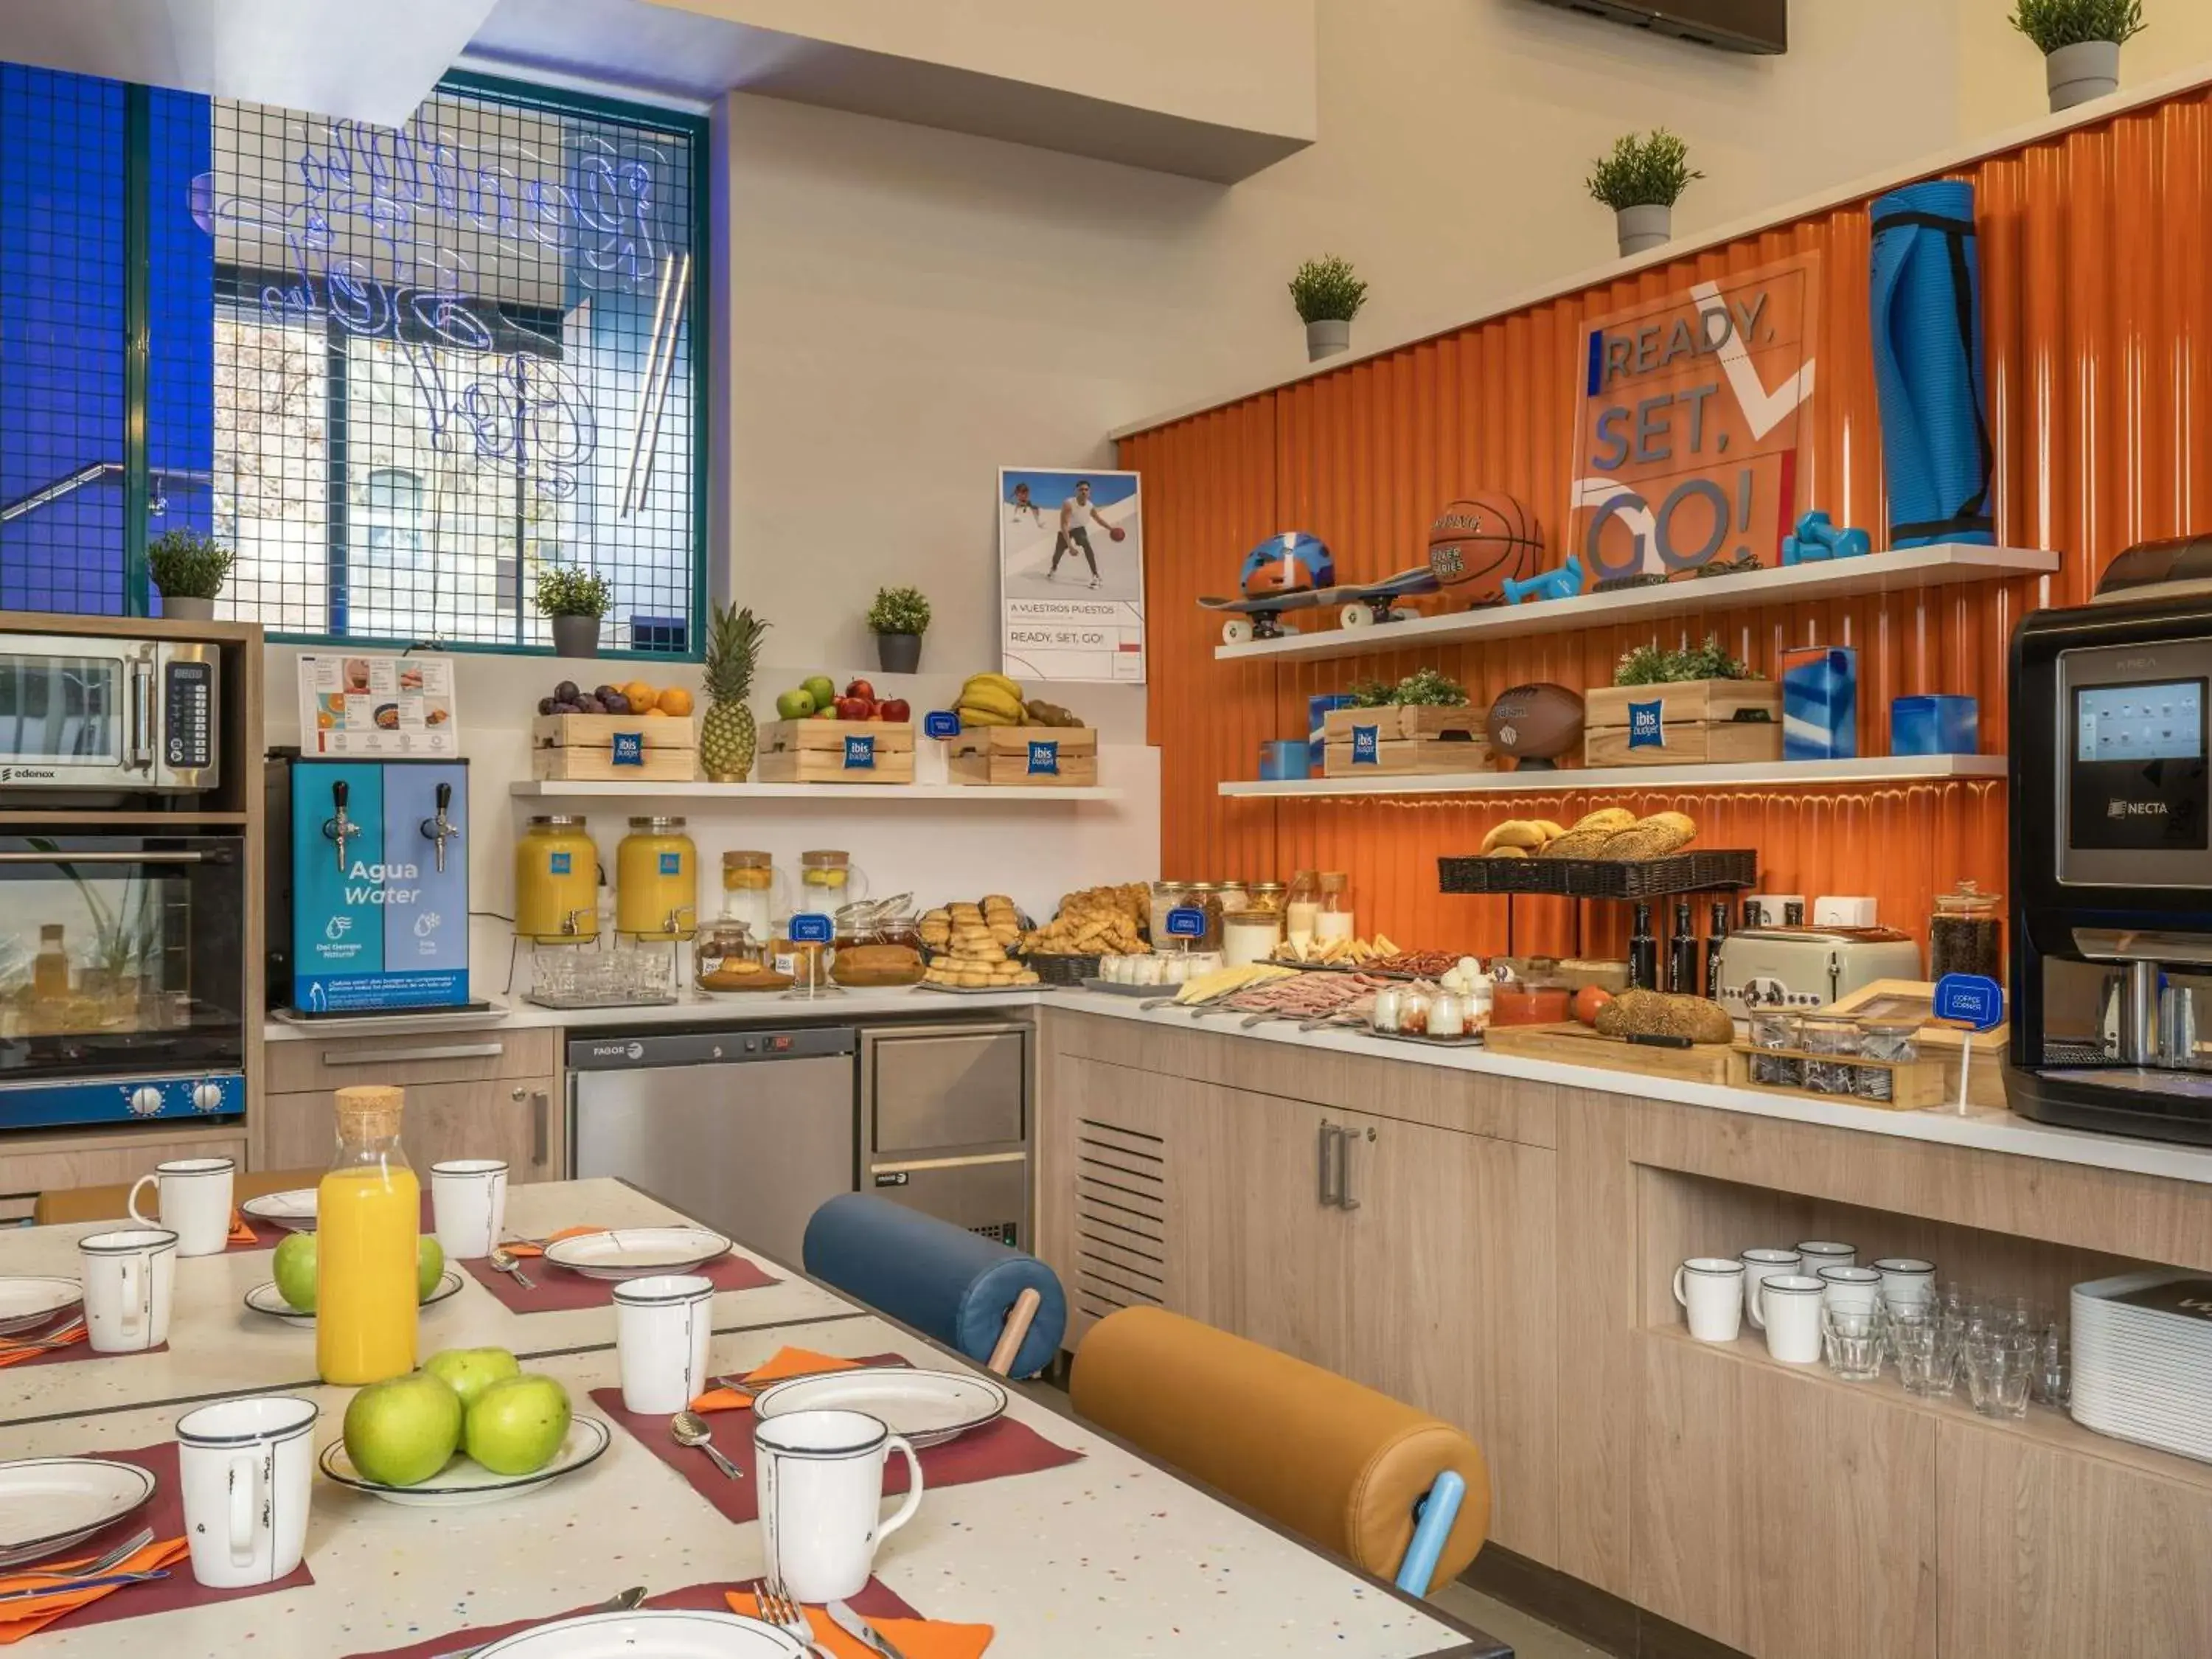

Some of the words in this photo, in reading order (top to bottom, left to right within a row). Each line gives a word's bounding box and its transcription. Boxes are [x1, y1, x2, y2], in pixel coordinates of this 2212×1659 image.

[1604, 292, 1775, 383] READY,
[1591, 383, 1730, 471] SET,
[1587, 469, 1753, 578] GO!
[1011, 604, 1018, 612] A
[1020, 604, 1070, 613] VUESTROS
[1071, 606, 1114, 614] PUESTOS
[1011, 631, 1052, 643] READY,
[1055, 633, 1079, 644] SET,
[1082, 633, 1104, 644] GO!
[1635, 710, 1656, 726] ibis
[1633, 724, 1659, 737] budget
[1357, 733, 1372, 745] ibis
[851, 742, 869, 753] ibis
[1034, 746, 1052, 759] ibis
[1032, 758, 1054, 768] budget
[15, 768, 55, 779] edenox
[2127, 801, 2170, 815] NECTA
[349, 860, 418, 884] Agua
[344, 886, 422, 905] Water
[1952, 1001, 1982, 1012] CORNER
[594, 1046, 625, 1056] FAGOR
